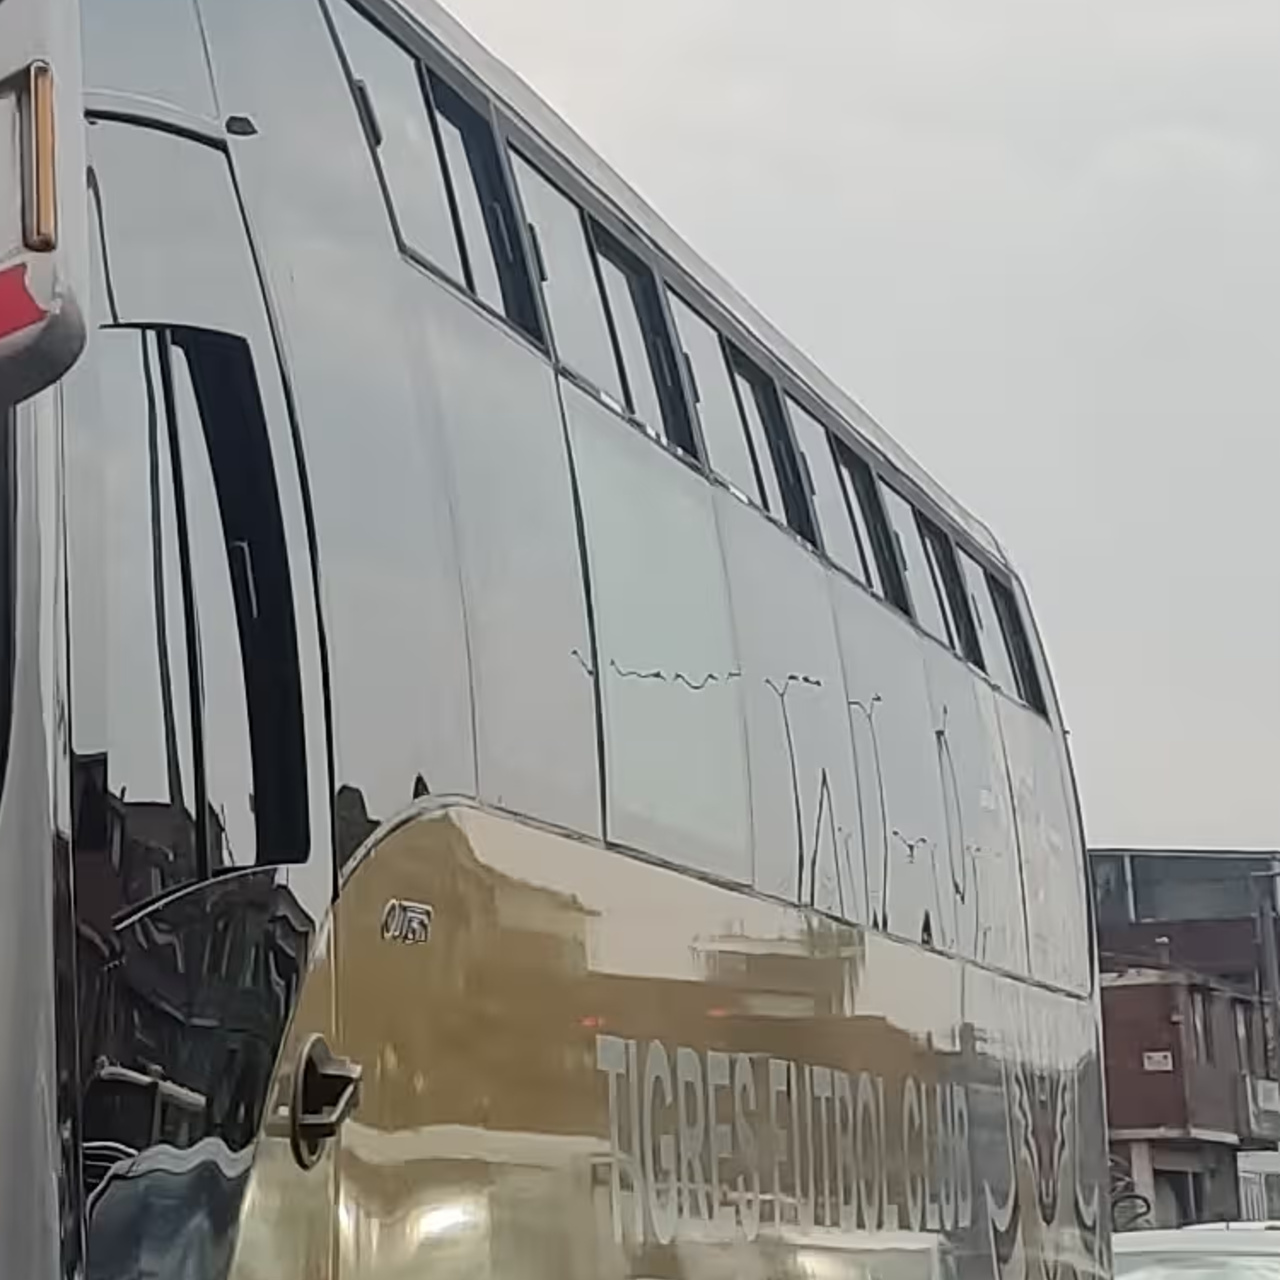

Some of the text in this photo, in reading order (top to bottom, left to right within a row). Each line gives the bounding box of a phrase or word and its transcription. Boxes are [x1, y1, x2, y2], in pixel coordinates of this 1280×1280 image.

[595, 1033, 973, 1247] TIGRES FUTBOL CLUB
